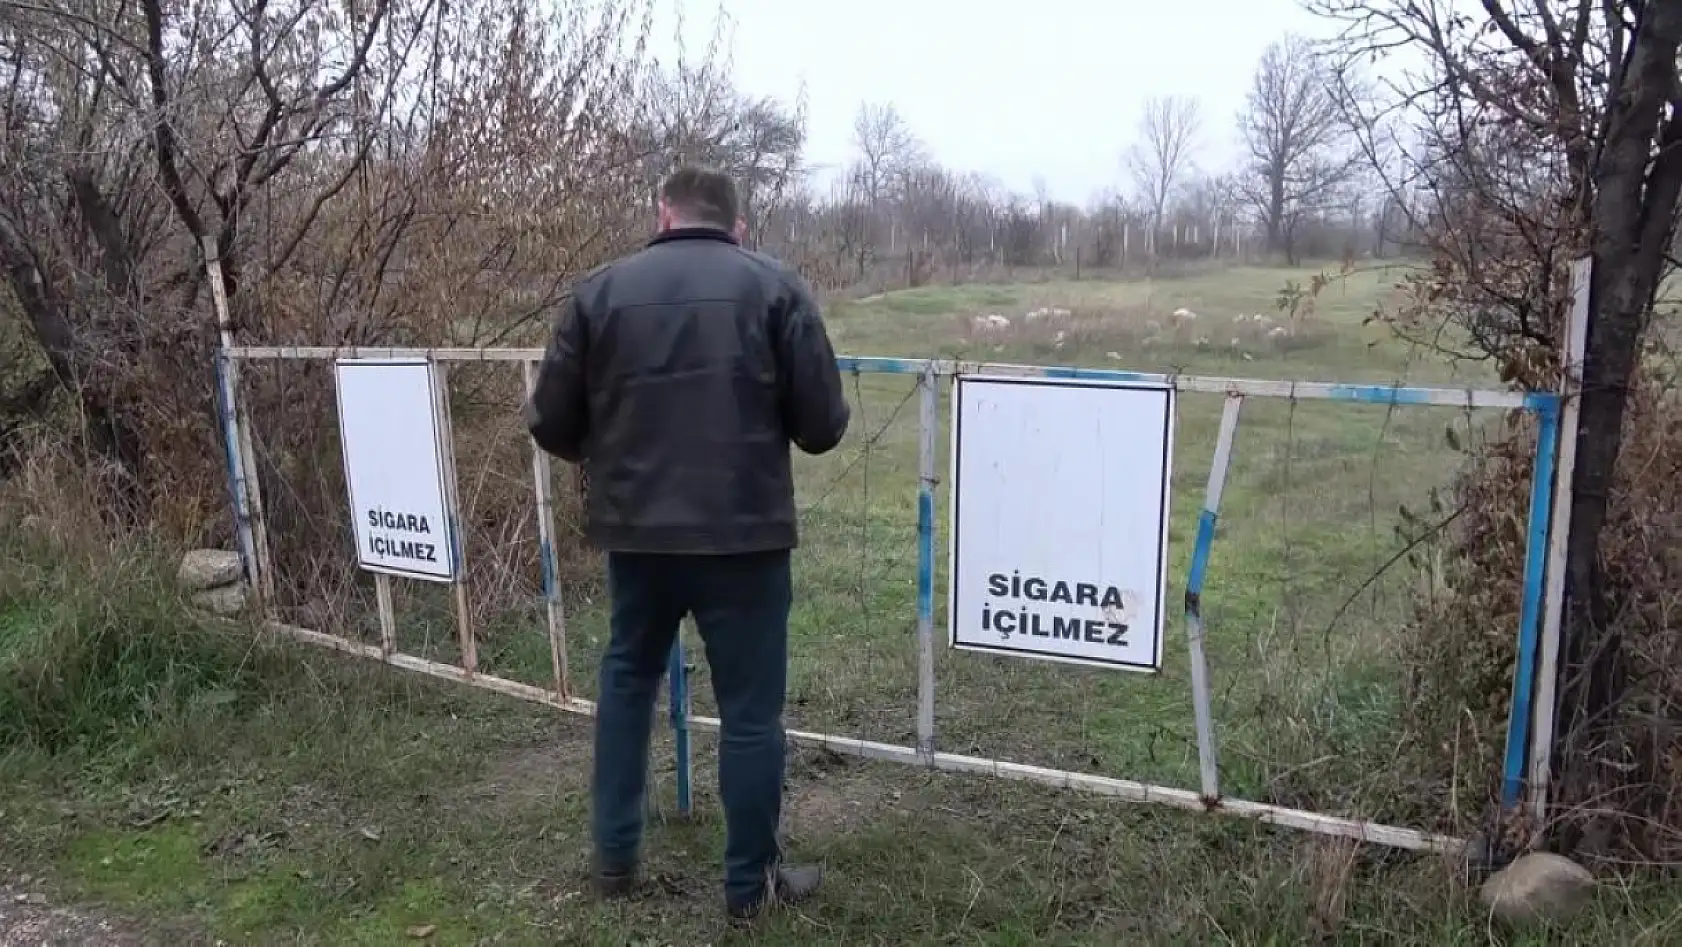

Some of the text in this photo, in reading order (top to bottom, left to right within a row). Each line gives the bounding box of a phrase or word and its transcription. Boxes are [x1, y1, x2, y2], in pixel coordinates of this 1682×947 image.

[368, 505, 431, 534] SİGARA
[369, 531, 437, 563] İÇİLMEZ
[988, 569, 1125, 610] SİGARA
[981, 602, 1129, 647] İÇİLMEZ
